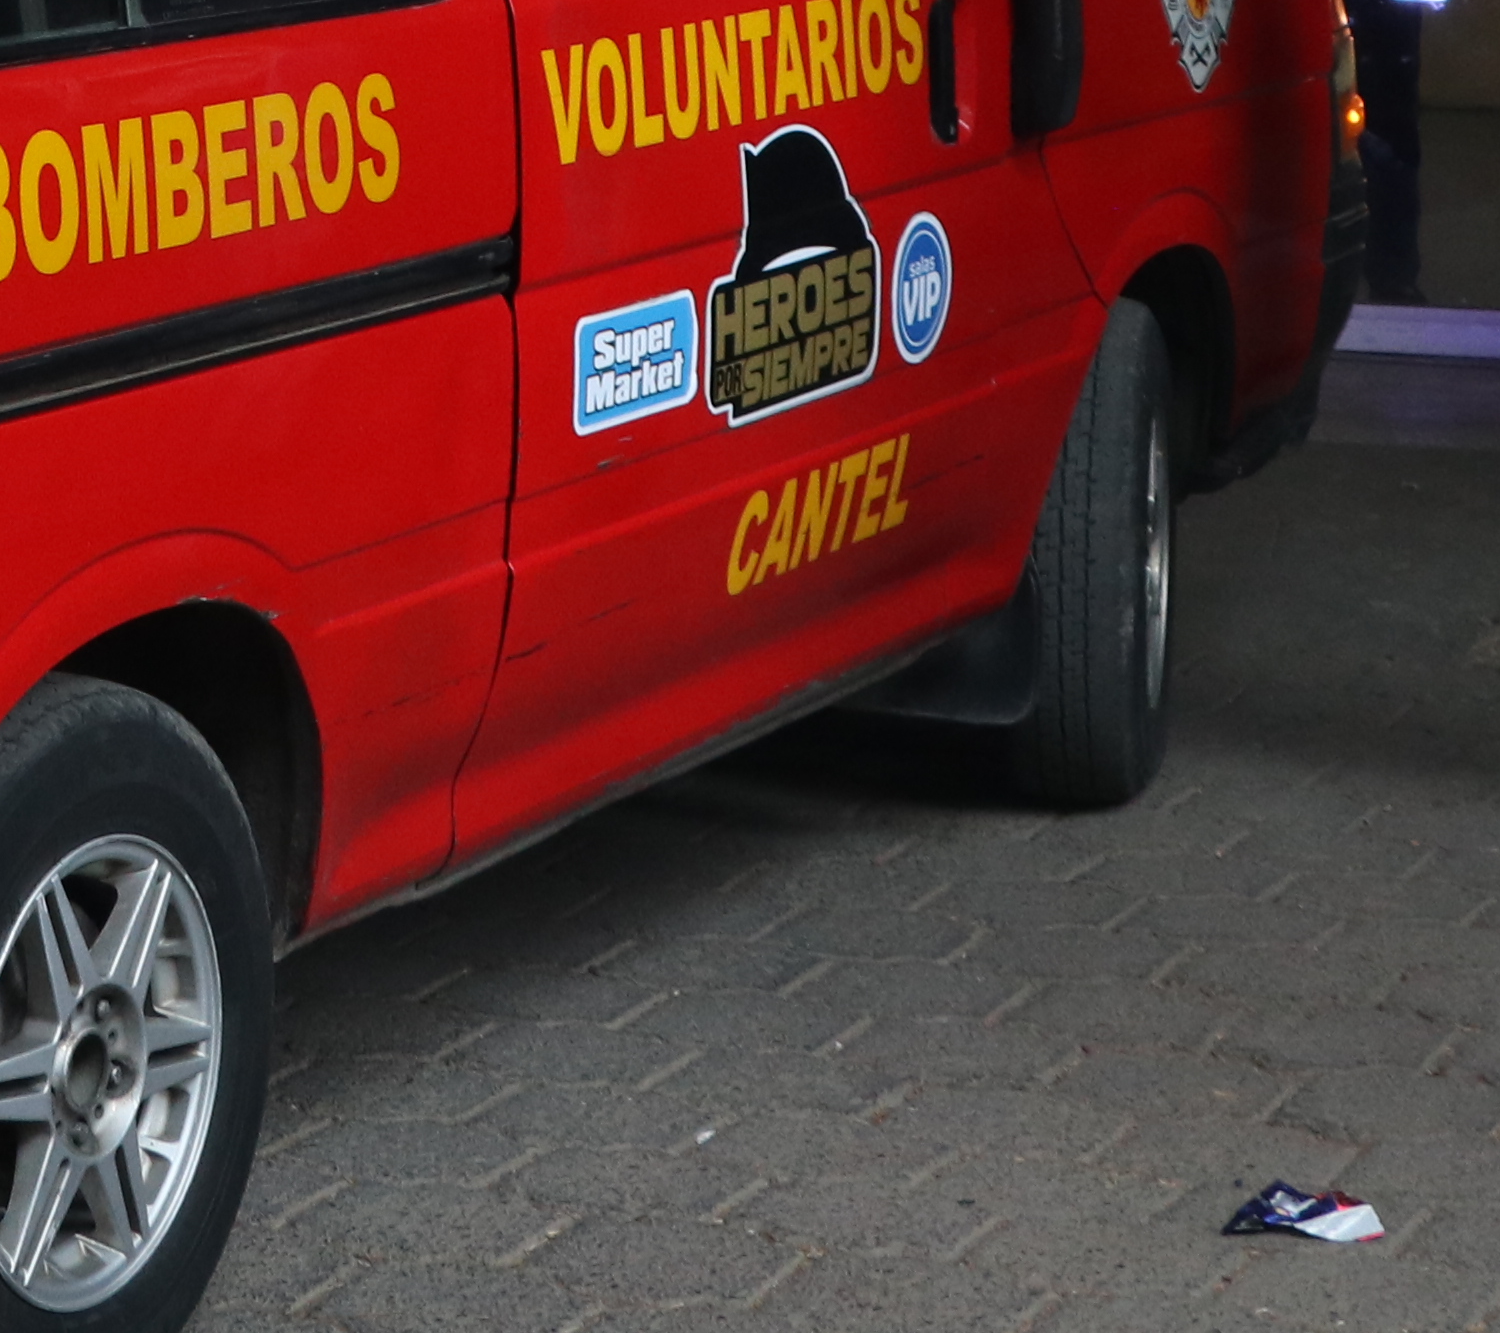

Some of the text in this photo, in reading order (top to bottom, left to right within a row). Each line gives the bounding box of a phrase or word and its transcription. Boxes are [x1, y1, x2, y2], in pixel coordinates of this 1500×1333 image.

[908, 254, 935, 278] salas
[713, 247, 873, 363] HEROES
[901, 272, 942, 326] VIP
[593, 319, 675, 370] Super
[715, 320, 869, 408] POR SIEMPRE
[585, 350, 684, 414] Market
[726, 433, 911, 597] CANTEL
